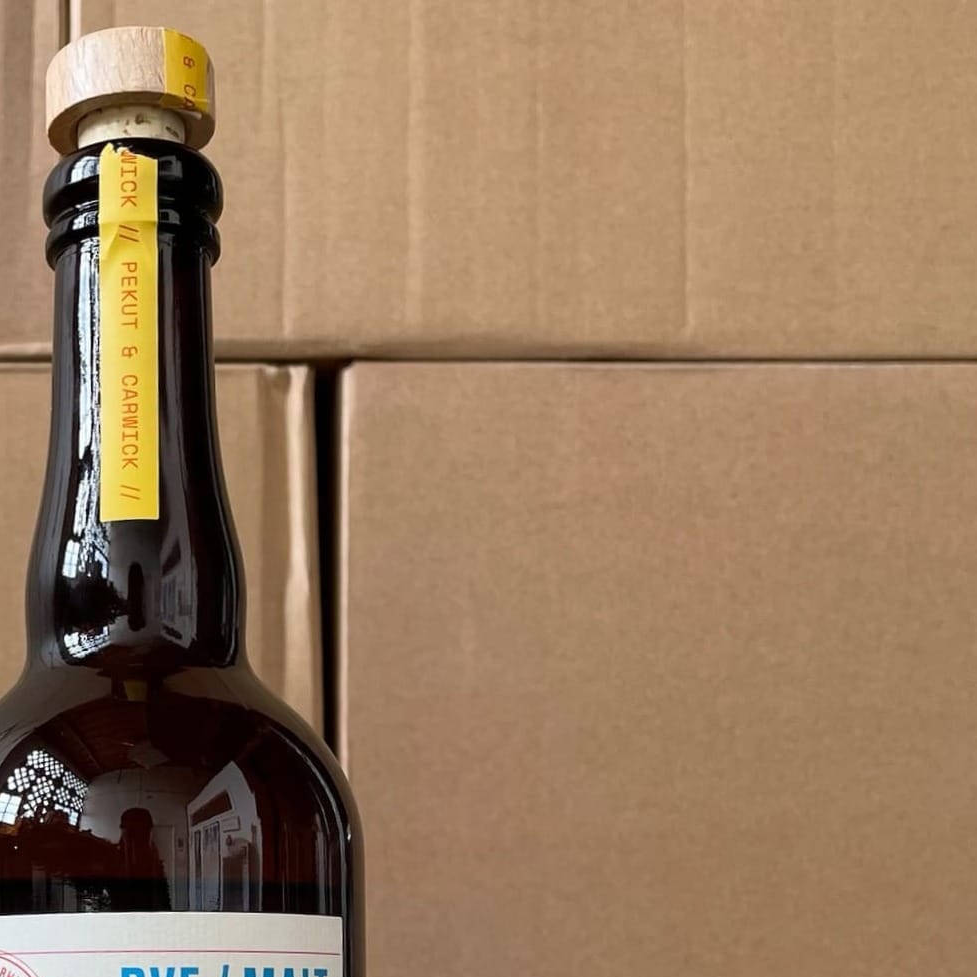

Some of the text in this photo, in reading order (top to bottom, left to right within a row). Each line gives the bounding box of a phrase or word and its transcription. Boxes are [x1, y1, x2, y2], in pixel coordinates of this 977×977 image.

[121, 262, 138, 329] PEKUT
[121, 346, 138, 359] &
[121, 374, 139, 469] CARWICK
